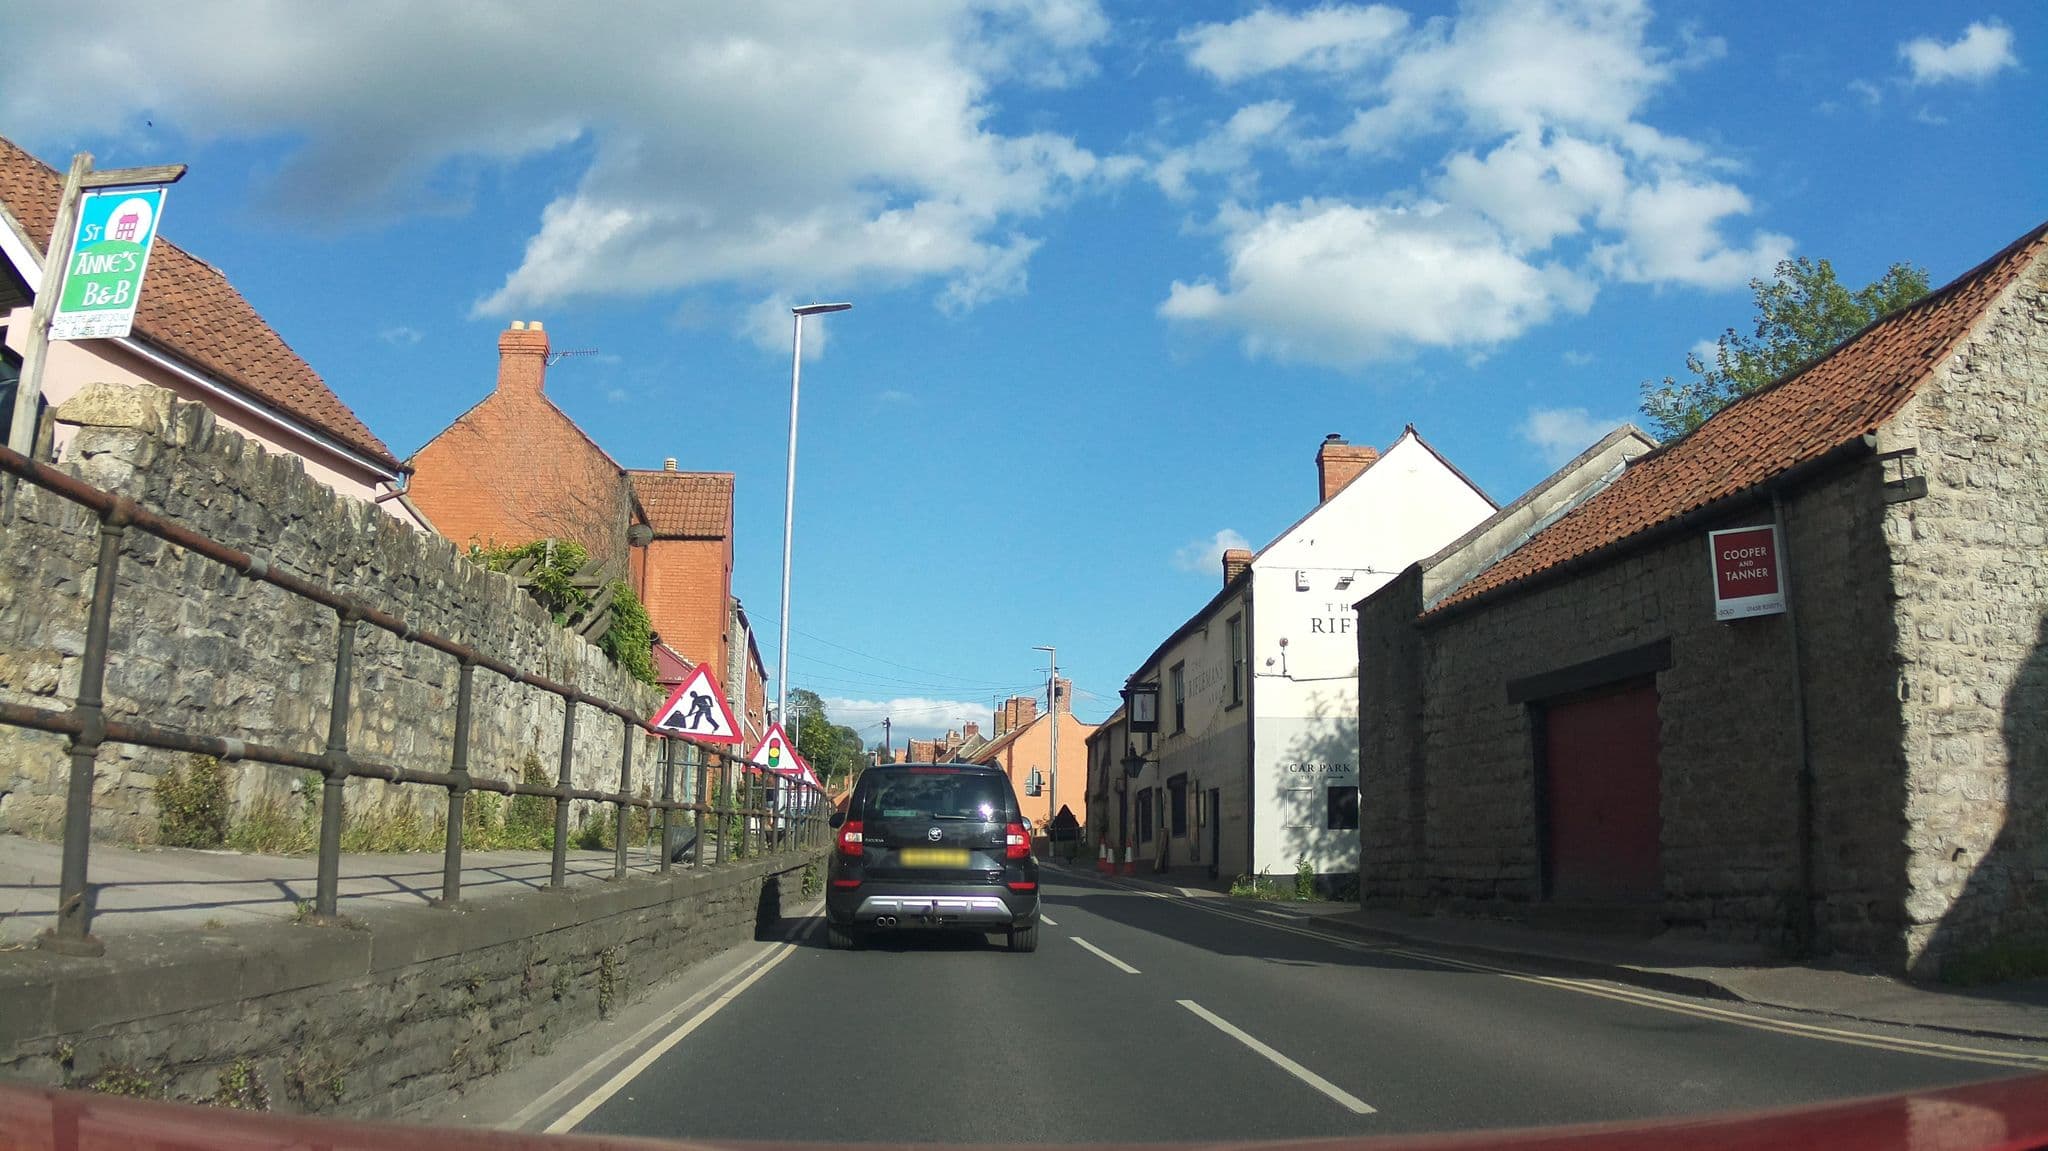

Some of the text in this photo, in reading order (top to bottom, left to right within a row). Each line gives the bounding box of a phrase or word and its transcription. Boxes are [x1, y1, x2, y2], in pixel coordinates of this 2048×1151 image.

[82, 279, 131, 307] B&B
[1723, 546, 1768, 560] COOPER
[1725, 567, 1769, 582] TANNER
[1325, 603, 1349, 612] TH
[1310, 617, 1358, 633] RIF
[1289, 763, 1351, 773] CAR PARK
